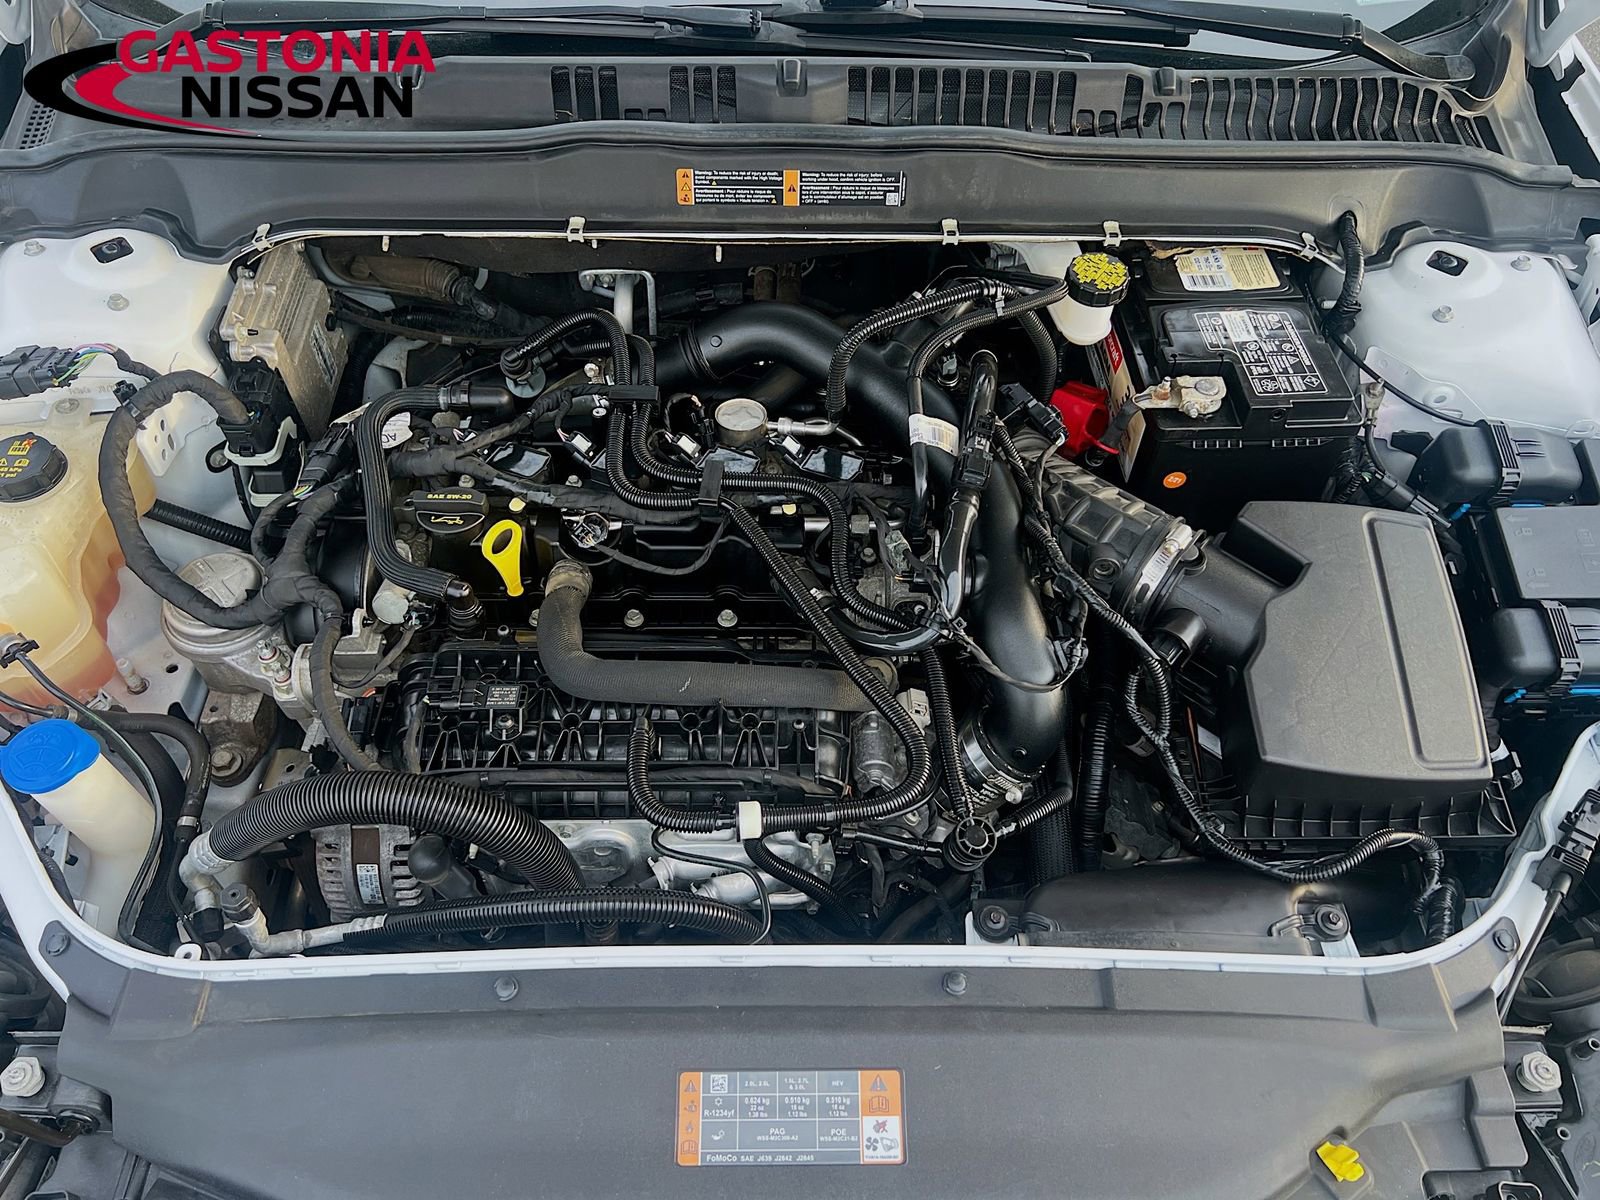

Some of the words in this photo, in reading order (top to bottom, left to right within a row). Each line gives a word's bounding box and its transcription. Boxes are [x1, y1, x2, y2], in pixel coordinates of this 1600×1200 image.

[762, 1097, 770, 1105] kg
[802, 1097, 810, 1105] kg
[843, 1096, 850, 1105] kg
[704, 1109, 735, 1118] R-1234yf
